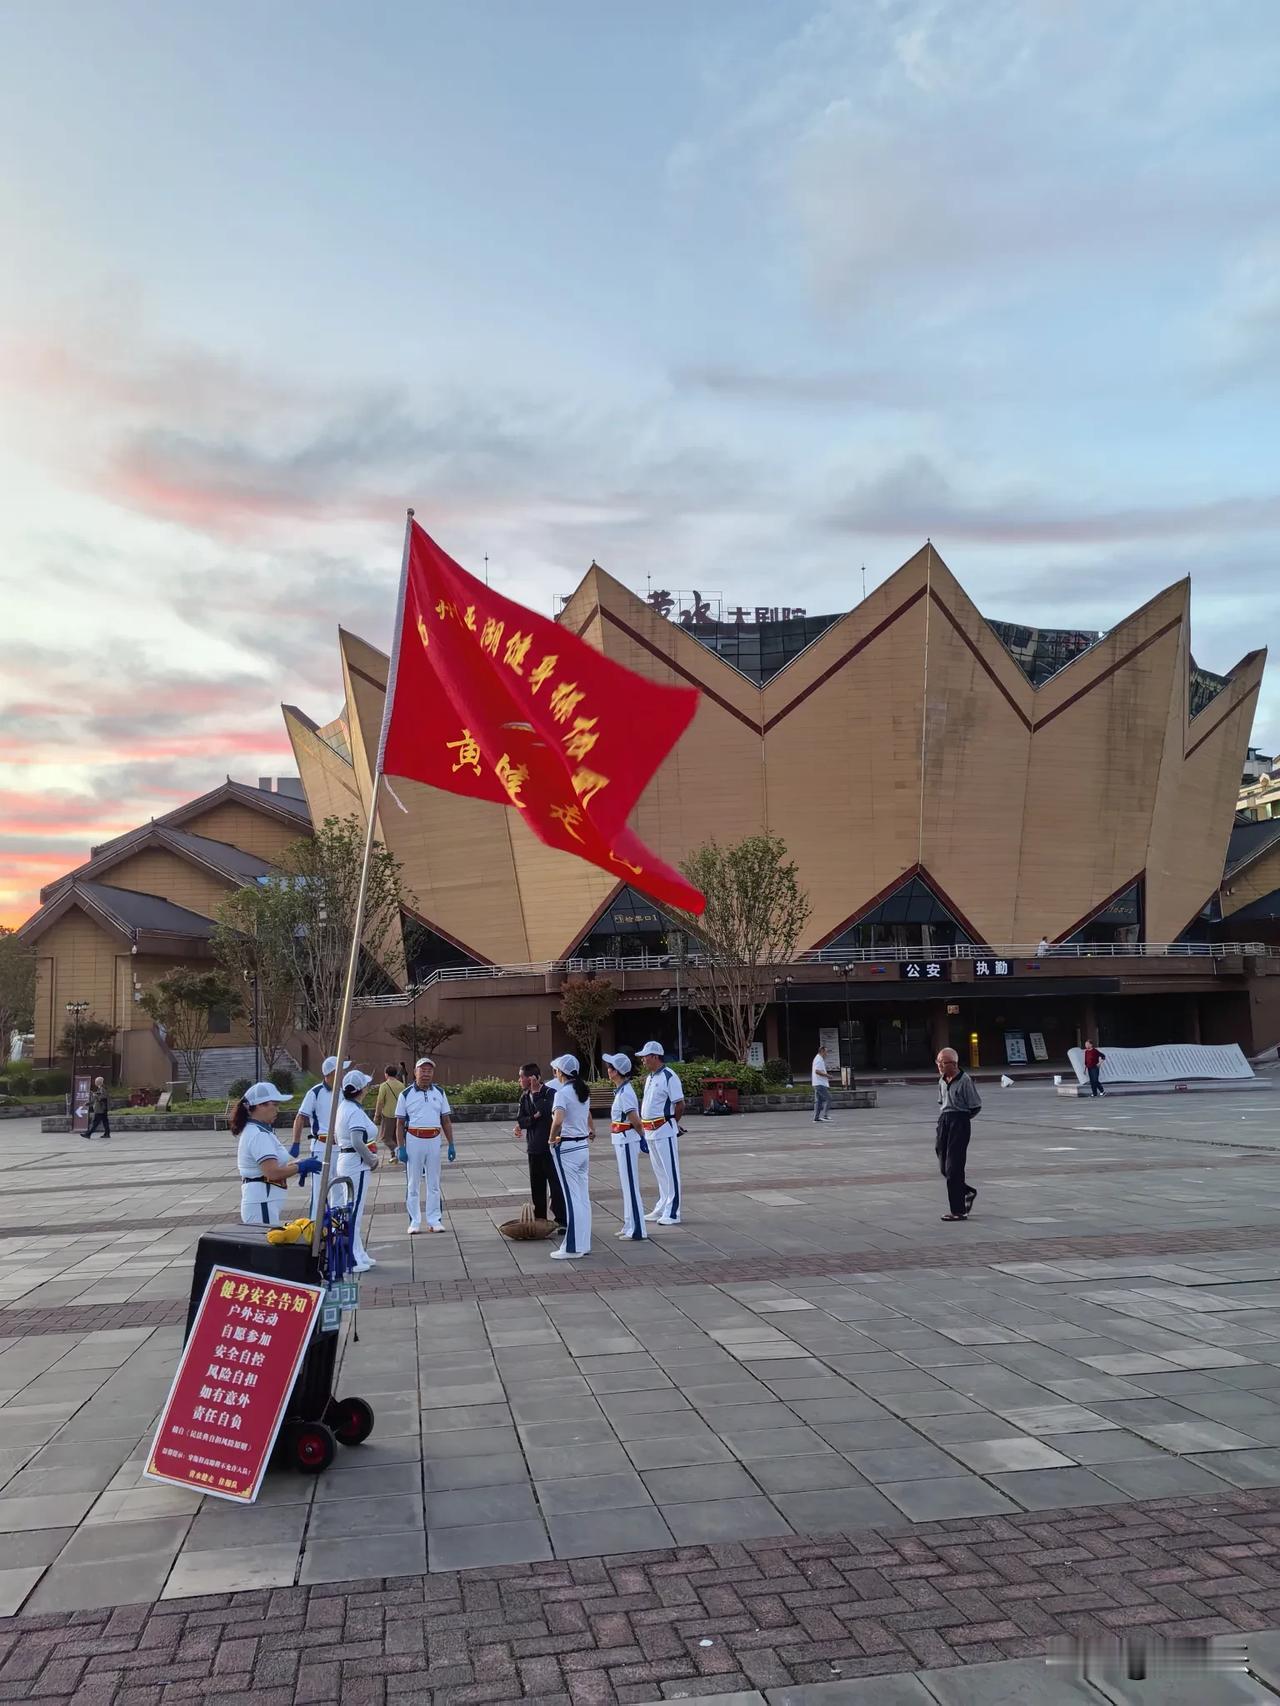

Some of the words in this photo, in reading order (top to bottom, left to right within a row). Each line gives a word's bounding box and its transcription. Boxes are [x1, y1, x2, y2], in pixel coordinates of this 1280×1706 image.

[906, 963, 941, 978] 公安
[976, 960, 1009, 976] 执勤
[220, 1279, 308, 1314] 健身安全告知
[227, 1304, 280, 1327] 户外运动
[221, 1323, 272, 1347] 自愿参加
[213, 1344, 266, 1368] 安全自控
[205, 1364, 259, 1388] 风险自担
[199, 1384, 251, 1409] 如有意外
[192, 1405, 242, 1431] 责任自负
